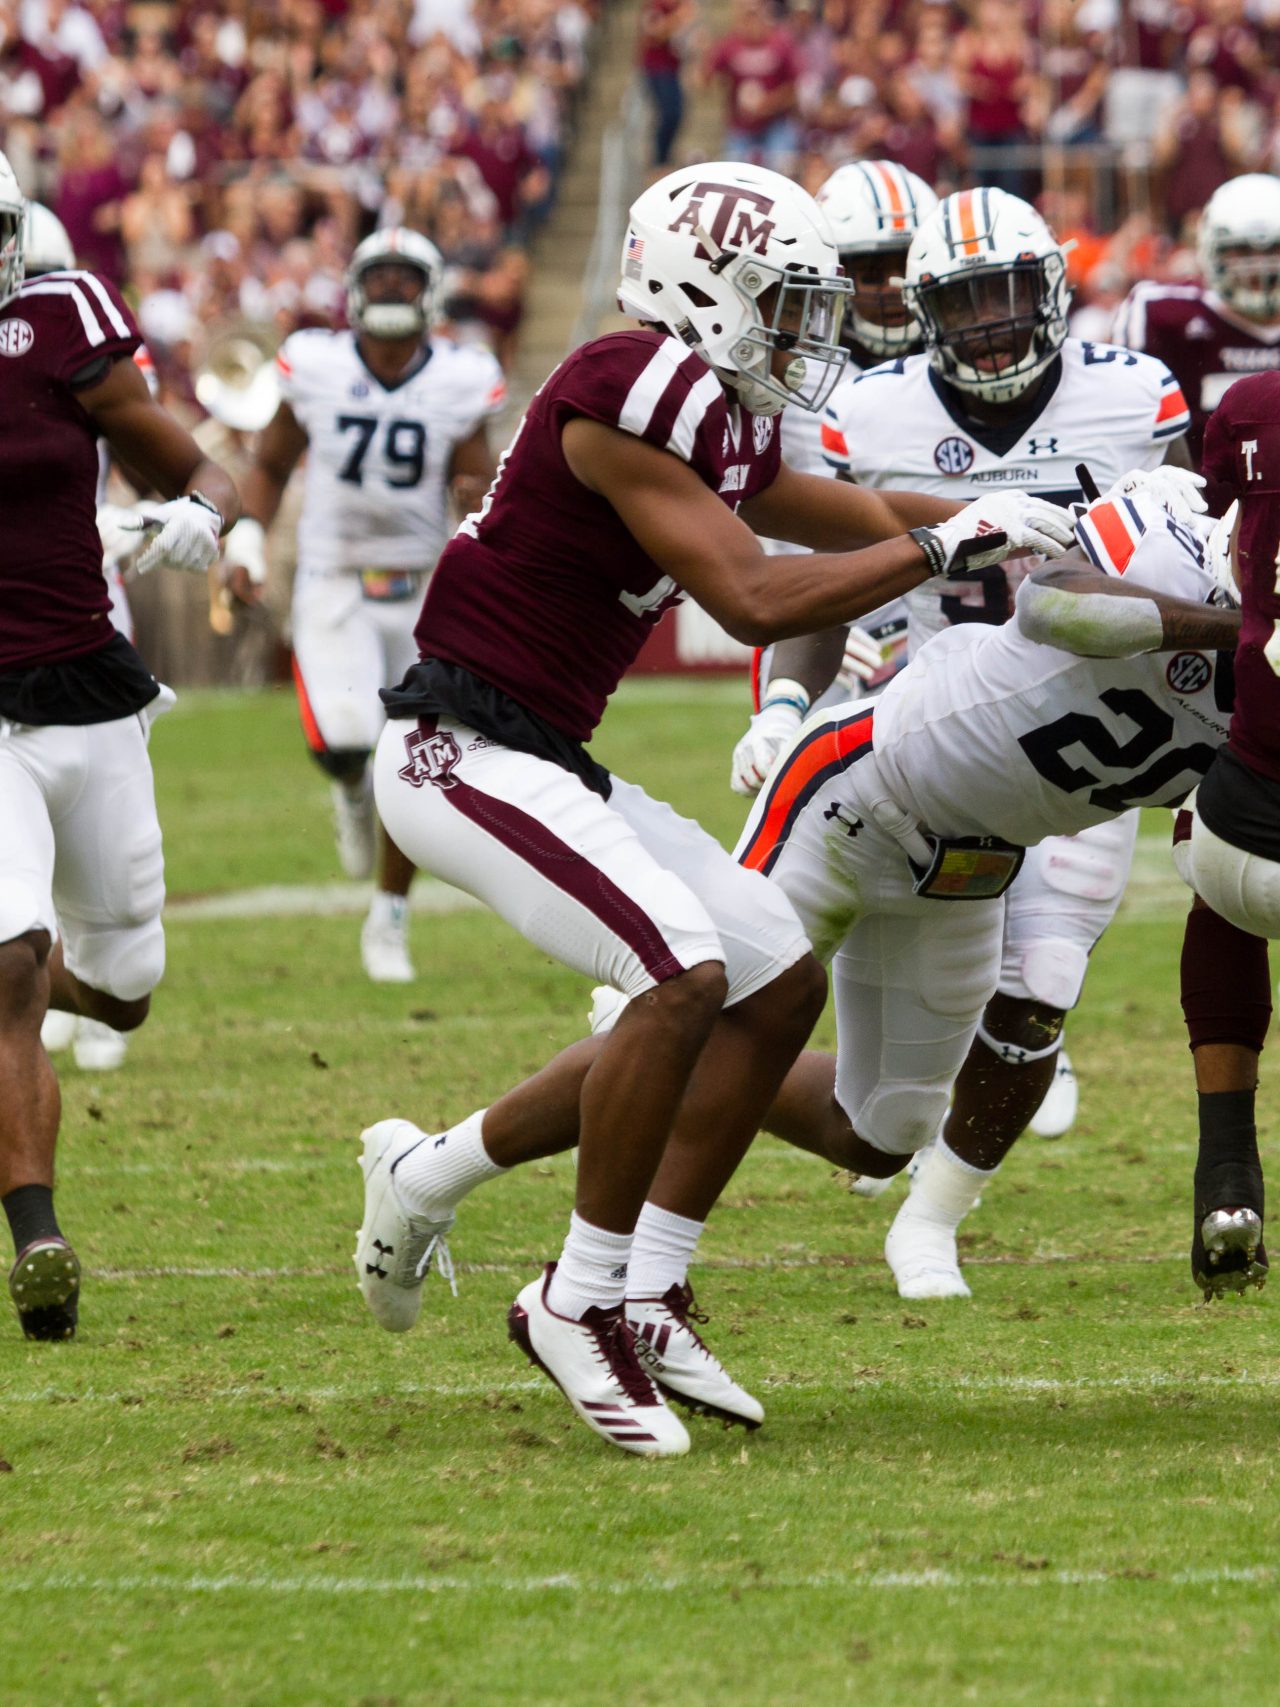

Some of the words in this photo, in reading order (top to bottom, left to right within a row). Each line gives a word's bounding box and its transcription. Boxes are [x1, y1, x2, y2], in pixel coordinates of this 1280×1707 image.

[337, 415, 427, 488] 79
[936, 438, 972, 474] SEC
[1241, 440, 1263, 481] T.
[970, 467, 1039, 484] AUBURN
[1168, 652, 1211, 693] SEC
